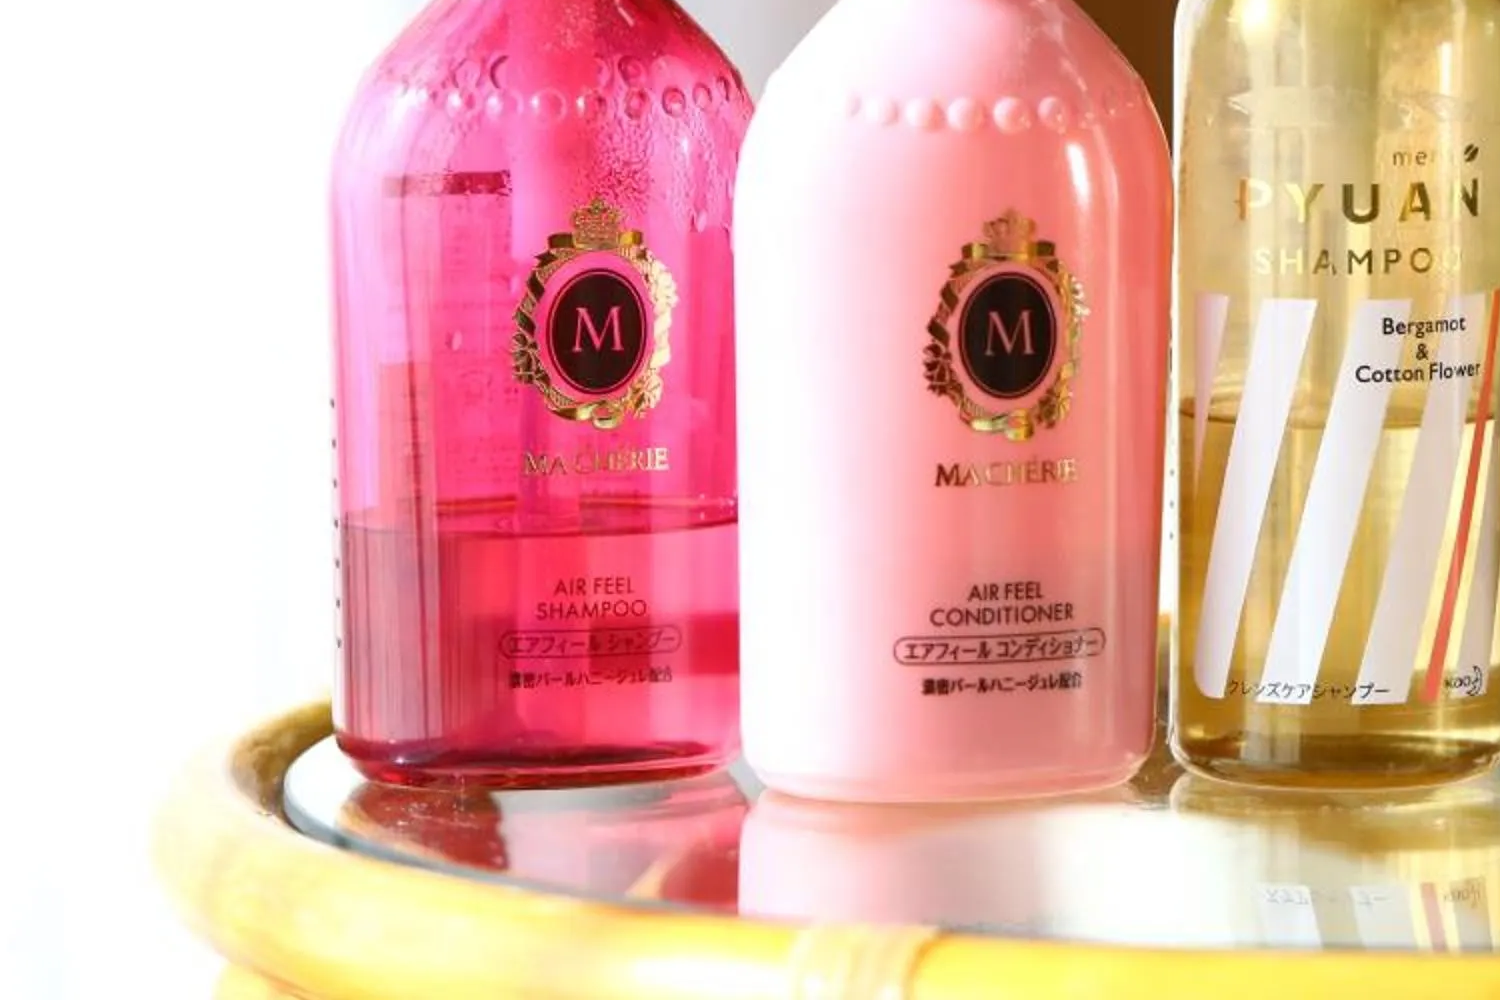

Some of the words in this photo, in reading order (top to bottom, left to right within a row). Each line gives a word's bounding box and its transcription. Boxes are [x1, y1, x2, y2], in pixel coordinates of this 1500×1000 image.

[1238, 177, 1479, 224] PYUAN
[1255, 247, 1461, 275] SHAMPOO
[573, 305, 625, 352] M
[985, 309, 1035, 356] M
[1382, 317, 1466, 338] Bergamot
[1416, 344, 1429, 360] &
[1355, 364, 1424, 384] Cotton
[1428, 362, 1480, 382] Flower
[553, 578, 587, 597] AIR
[592, 576, 635, 595] FEEL
[967, 583, 999, 602] AIR
[1005, 581, 1043, 600] FEEL
[536, 599, 647, 621] SHAMPOO
[929, 602, 1075, 627] CONDITIONER
[905, 641, 991, 661] エアフィール
[996, 635, 1099, 659] コンディショナー
